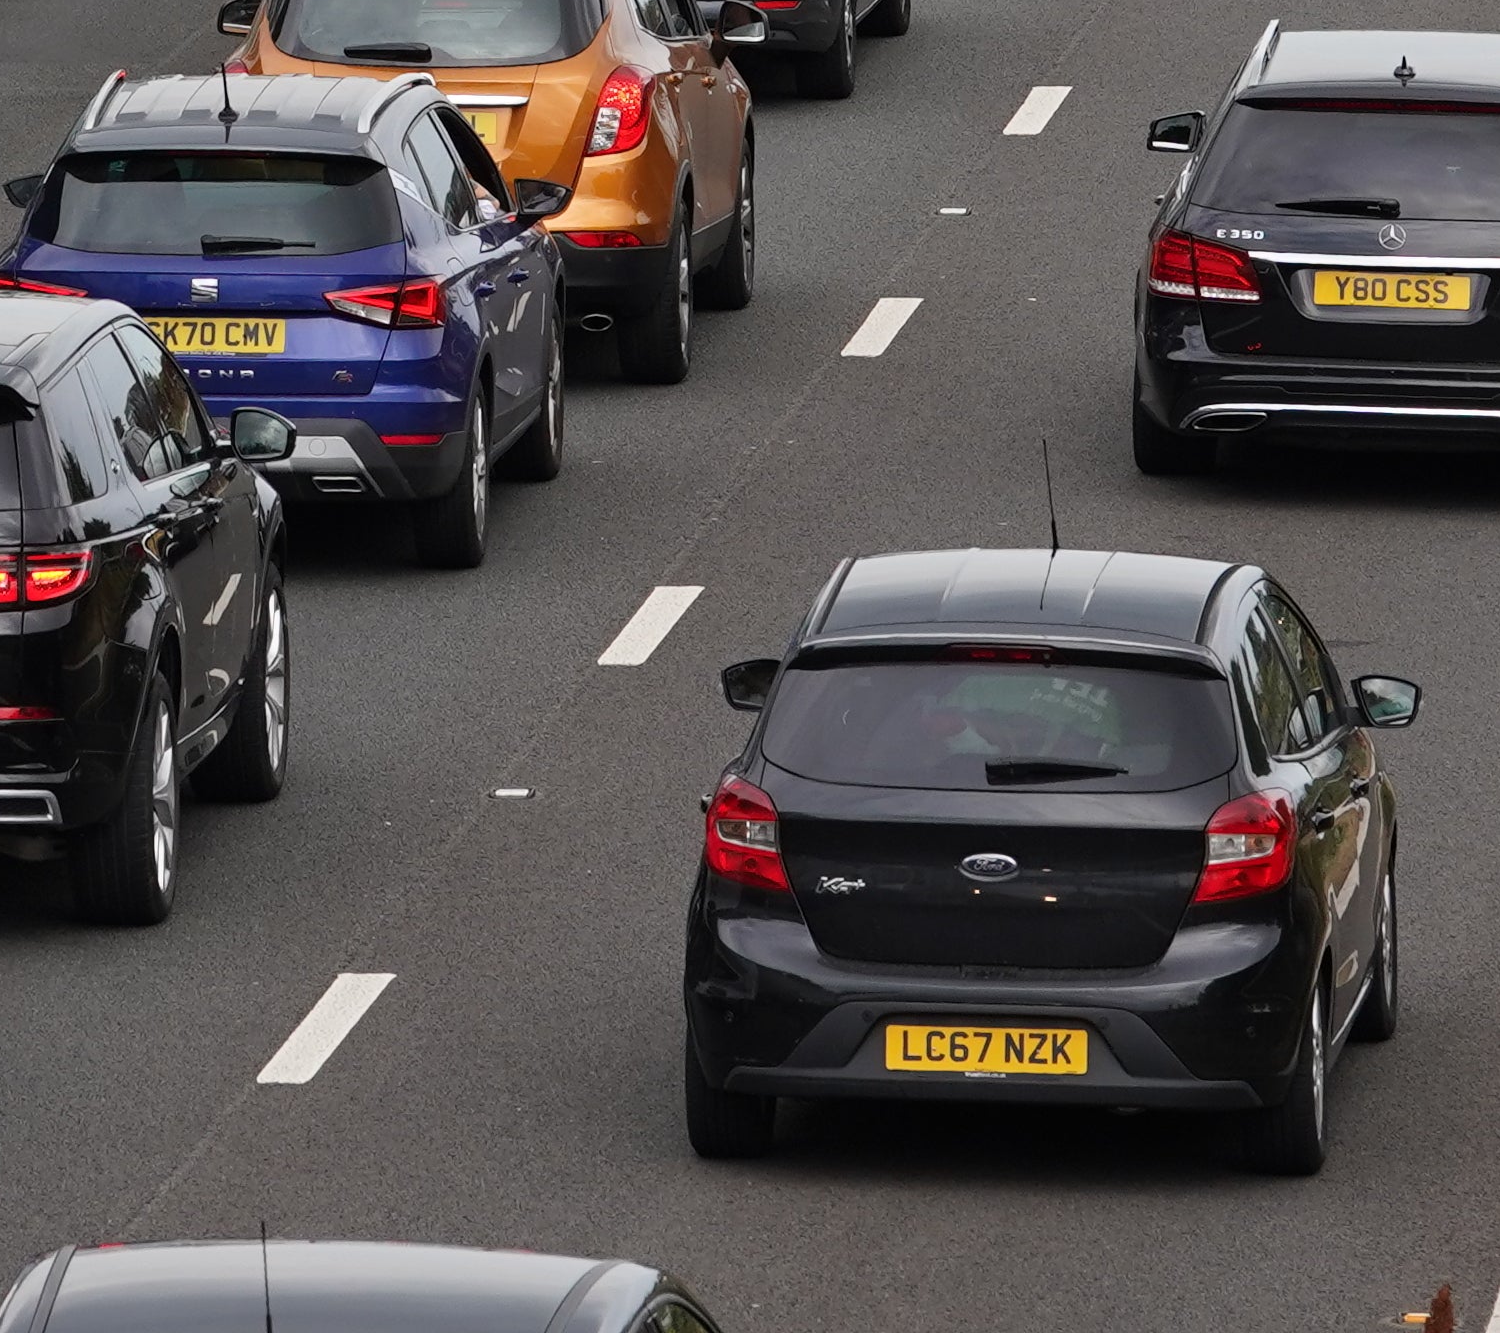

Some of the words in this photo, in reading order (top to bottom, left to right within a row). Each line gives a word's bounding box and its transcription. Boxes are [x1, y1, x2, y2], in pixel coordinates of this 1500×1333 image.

[1216, 229, 1227, 239] E
[1229, 229, 1265, 240] 350
[1334, 277, 1388, 302] Y80
[1395, 278, 1450, 304] CSS
[224, 321, 278, 347] CMV
[182, 368, 255, 379] ONA
[973, 858, 1006, 871] Ford
[902, 1030, 993, 1063] LC67
[1004, 1032, 1072, 1065] NZK
